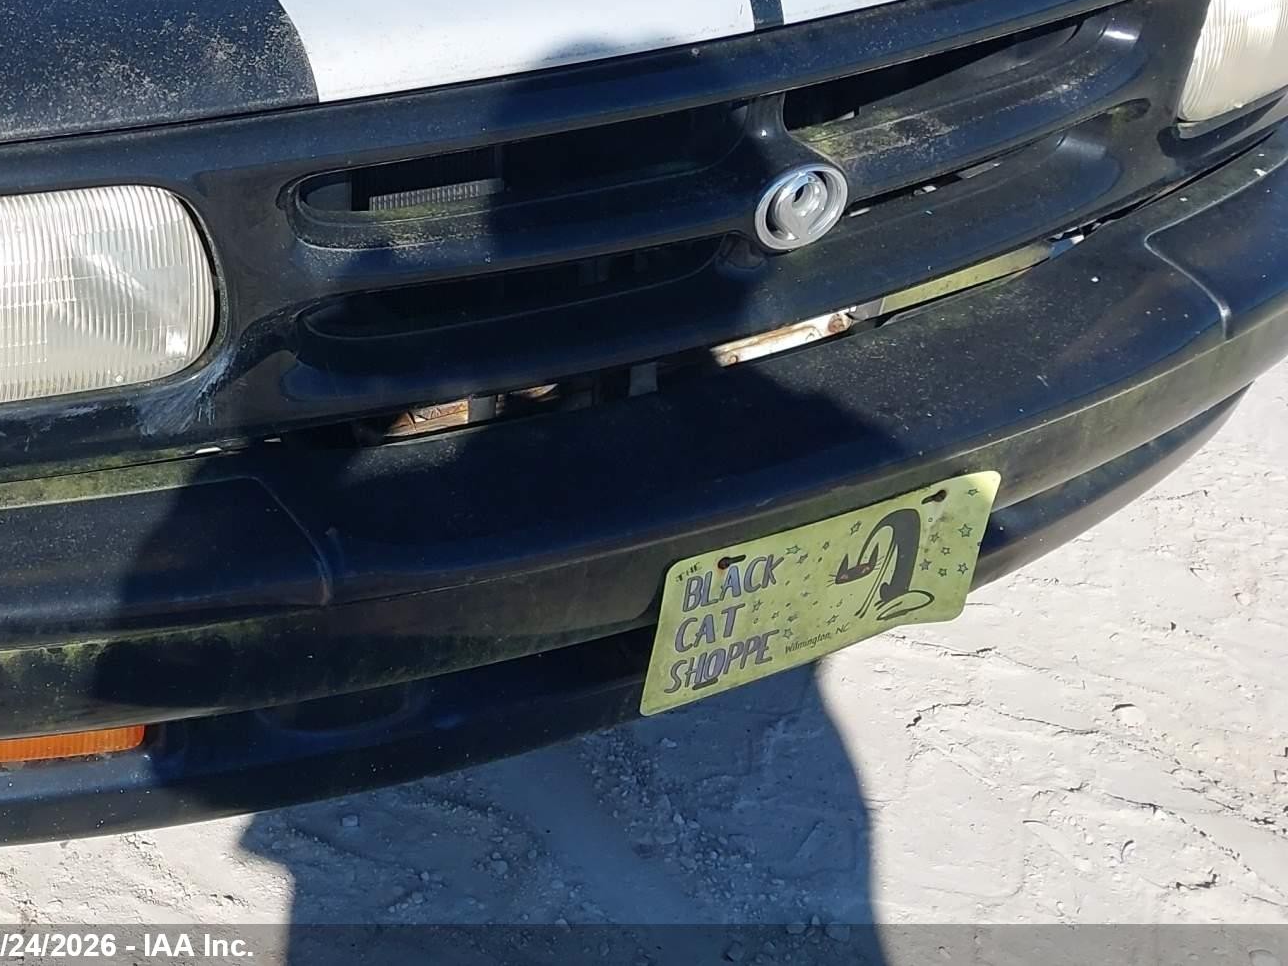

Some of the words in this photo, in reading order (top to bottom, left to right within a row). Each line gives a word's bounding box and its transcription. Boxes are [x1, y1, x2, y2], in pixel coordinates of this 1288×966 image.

[682, 555, 784, 612] BLACK
[674, 603, 746, 653] CAT
[664, 630, 779, 694] SHOPPE
